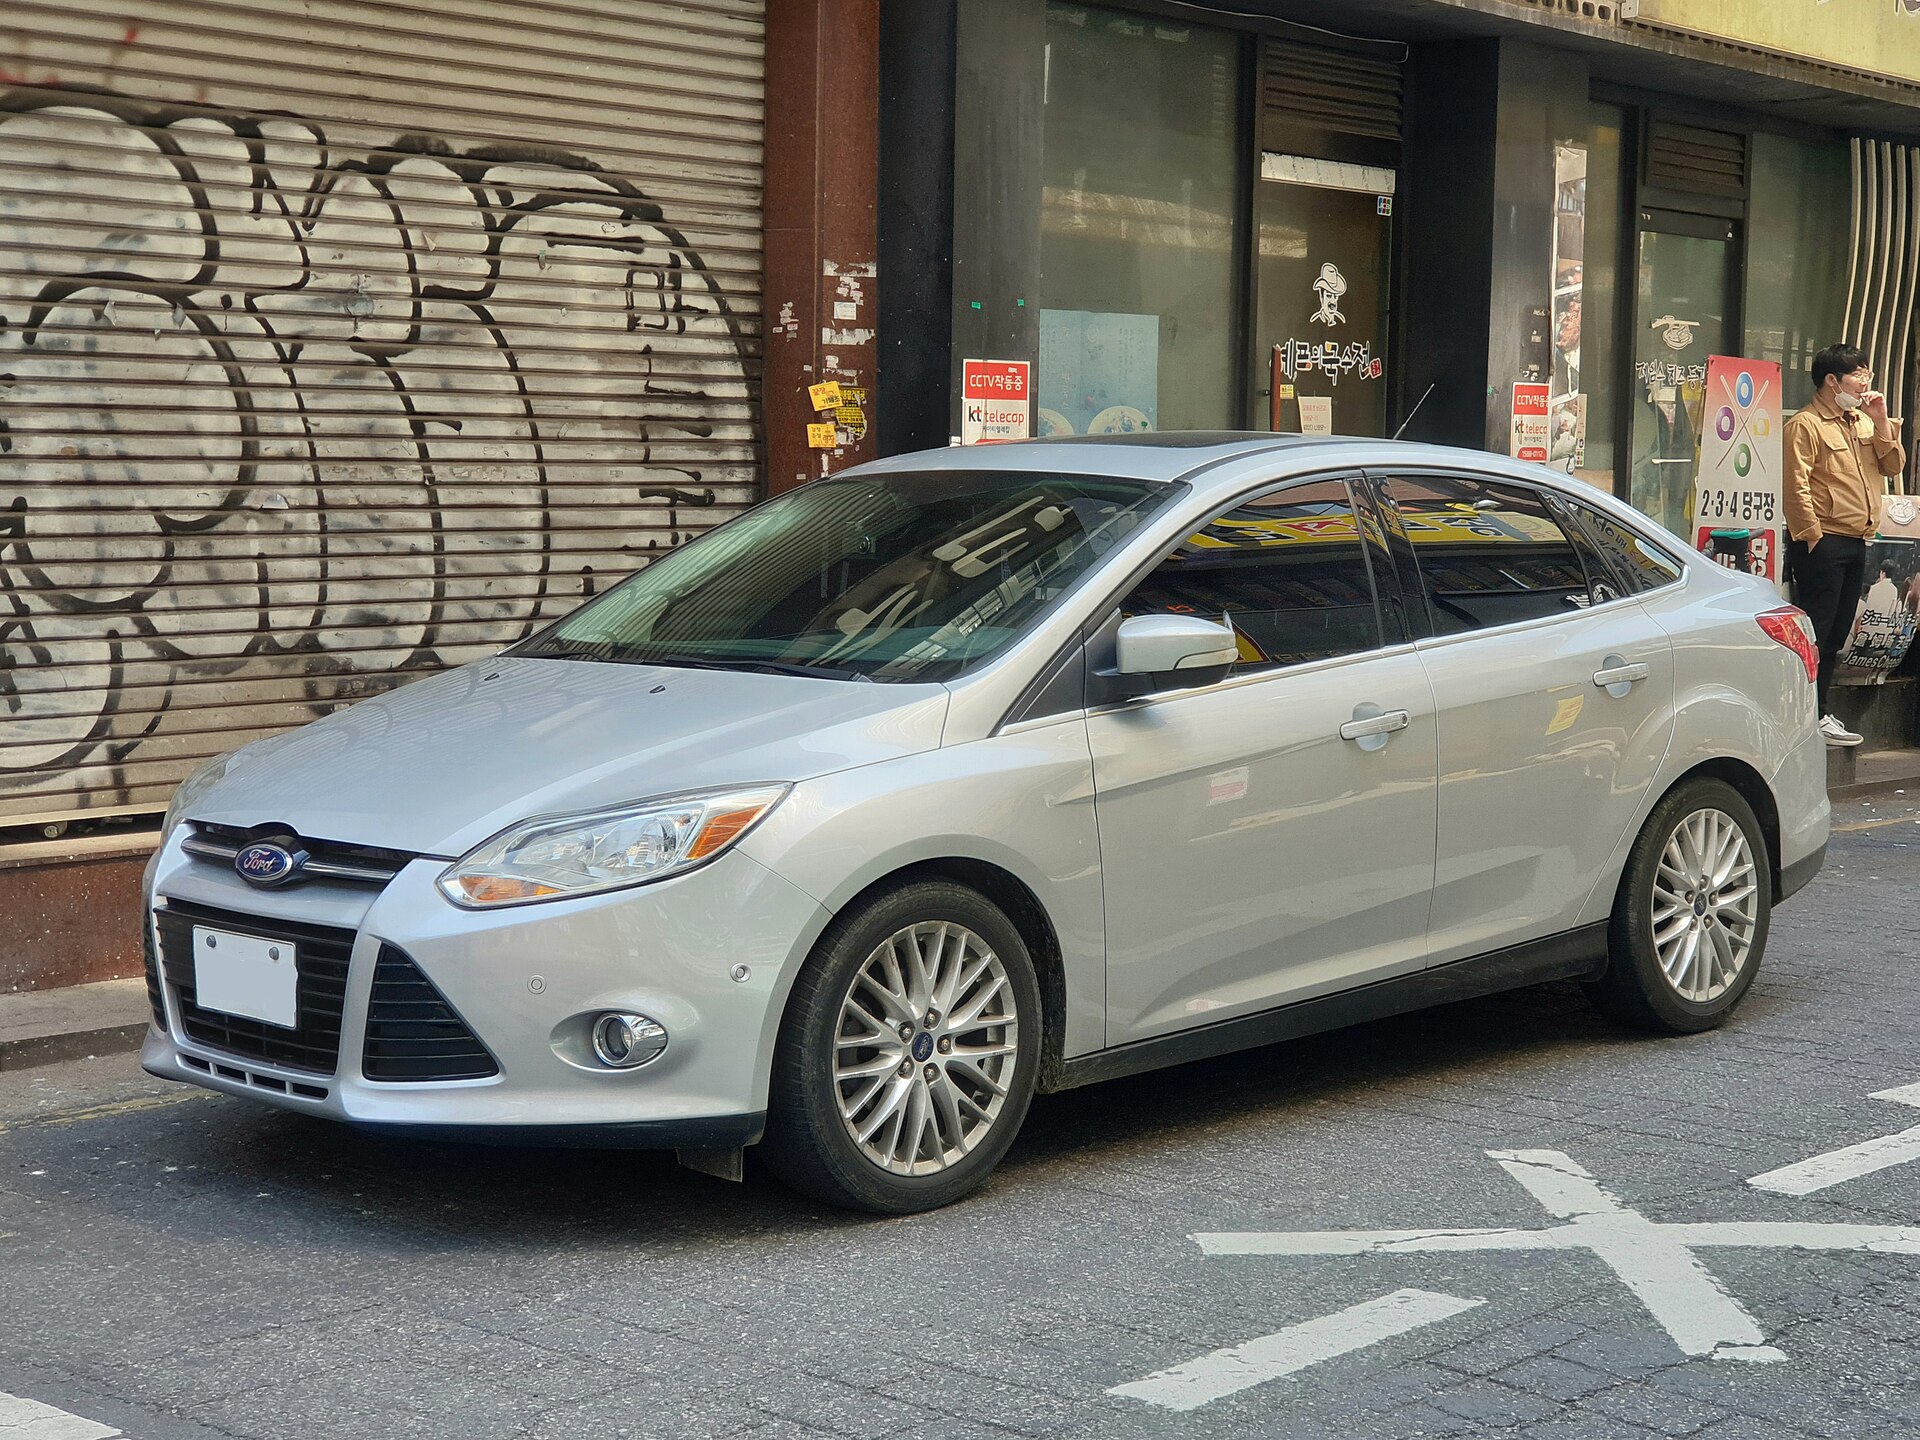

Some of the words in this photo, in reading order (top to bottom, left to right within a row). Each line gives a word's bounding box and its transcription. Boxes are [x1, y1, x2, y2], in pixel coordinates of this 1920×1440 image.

[968, 405, 982, 422] kt
[984, 409, 1024, 426] telecop
[1515, 420, 1524, 433] kt
[1525, 423, 1547, 434] teleco
[1743, 491, 1775, 521] 당구장
[243, 848, 276, 871] Ford
